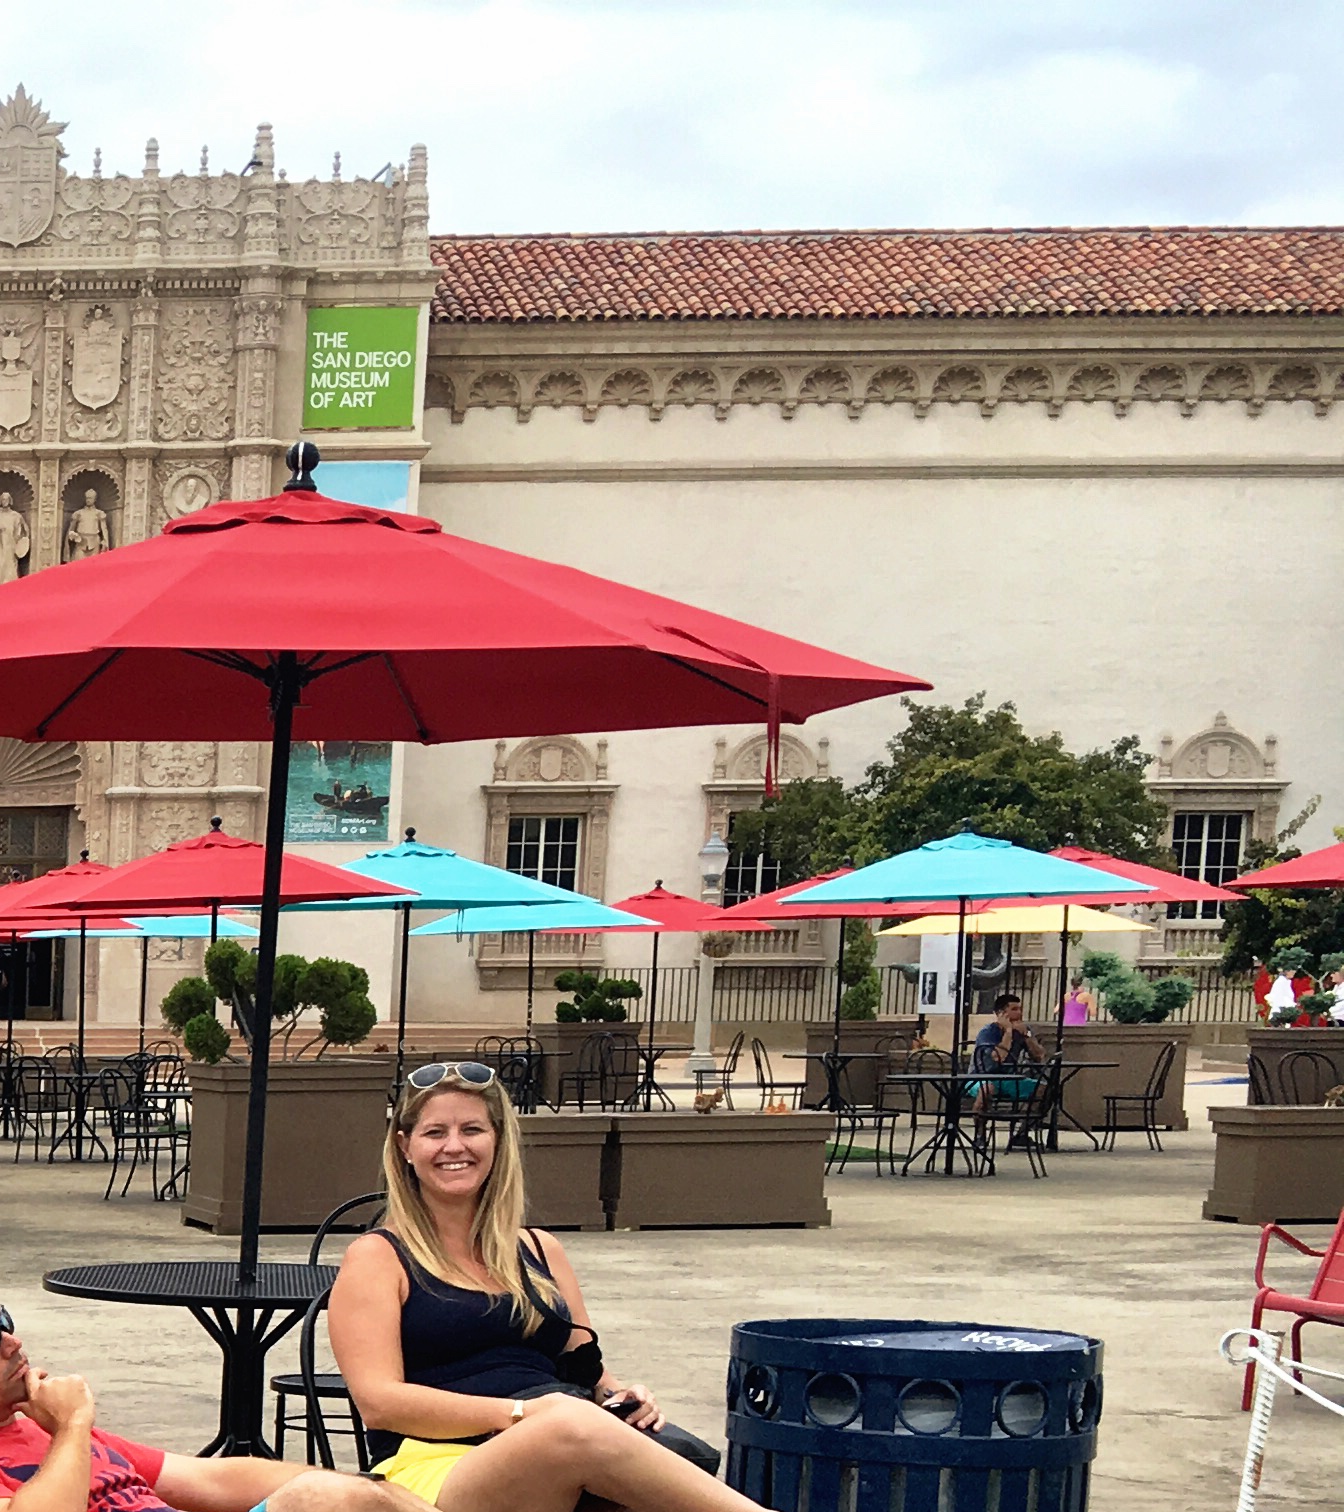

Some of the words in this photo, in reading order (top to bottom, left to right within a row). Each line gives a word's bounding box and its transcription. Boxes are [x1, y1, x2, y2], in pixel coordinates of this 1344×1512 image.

[313, 332, 349, 349] THE
[312, 352, 350, 369] SAN
[355, 351, 411, 368] DIEGO
[311, 372, 389, 389] MUSEUM
[310, 391, 335, 409] OF
[339, 391, 376, 408] ART
